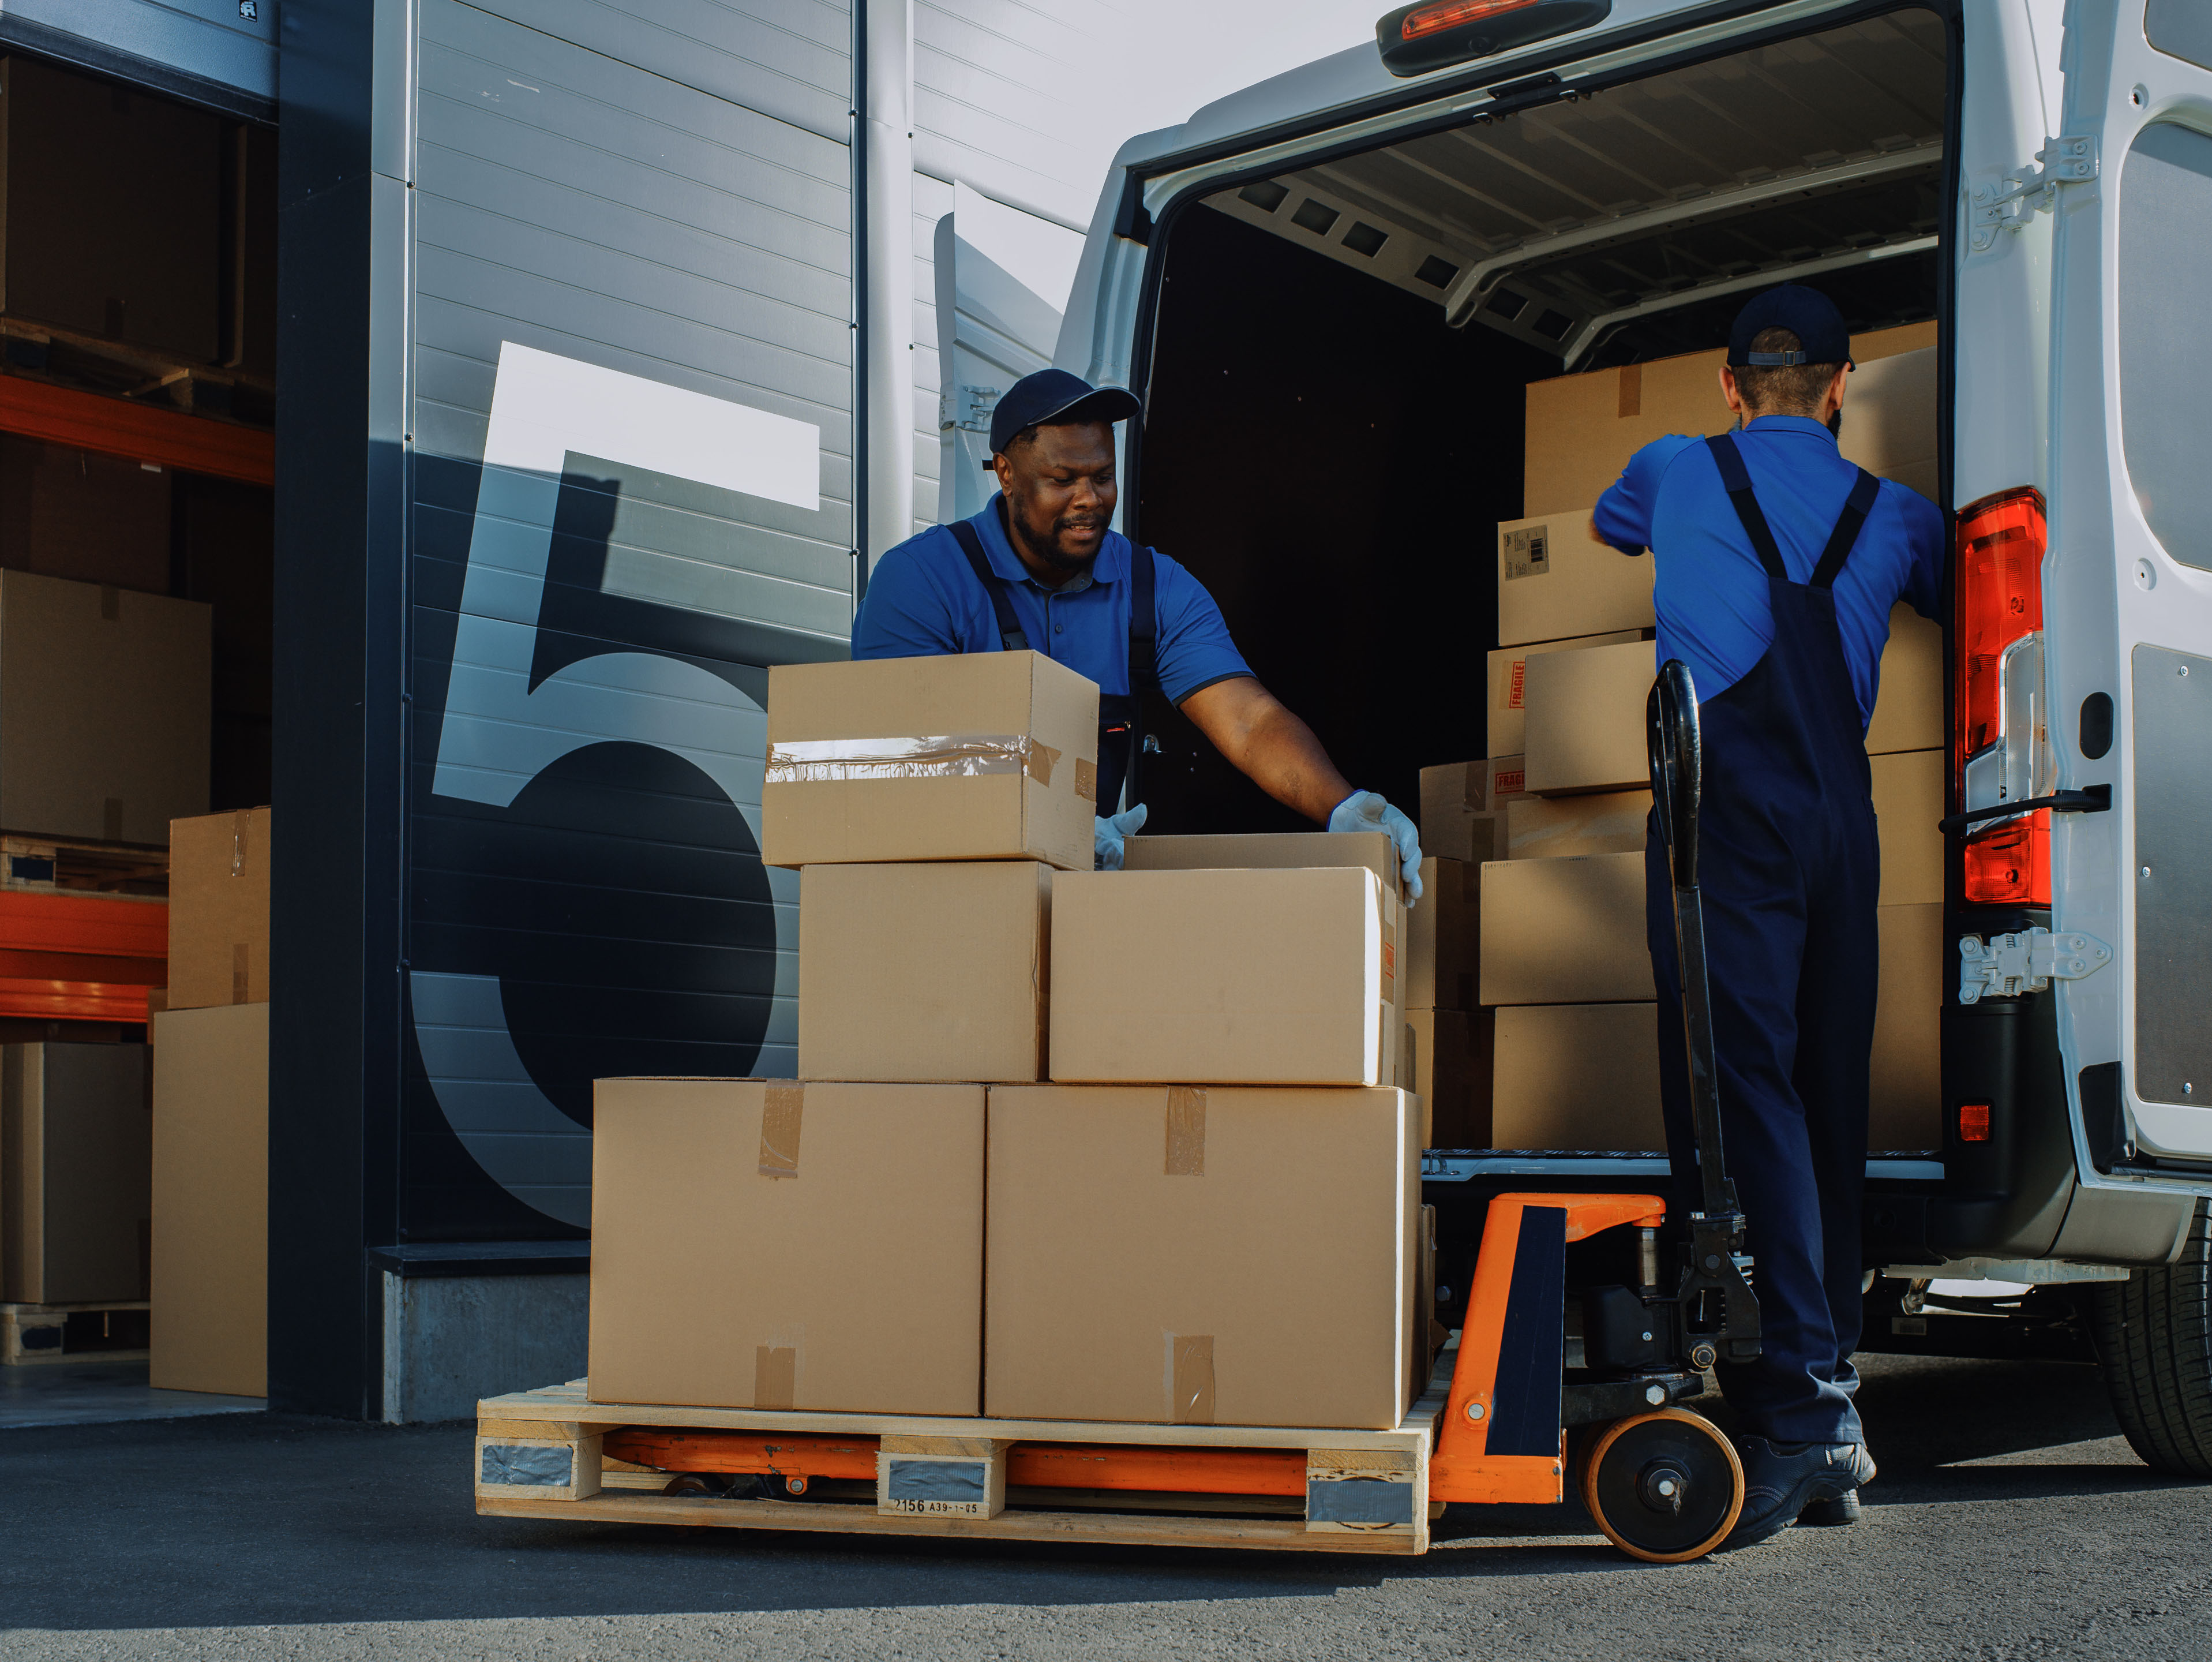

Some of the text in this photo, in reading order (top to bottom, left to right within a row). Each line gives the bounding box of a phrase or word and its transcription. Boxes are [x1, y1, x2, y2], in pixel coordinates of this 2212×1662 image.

[1512, 665, 1524, 705] FRAGILE
[410, 340, 820, 1230] 5
[1498, 774, 1525, 787] FRAGI
